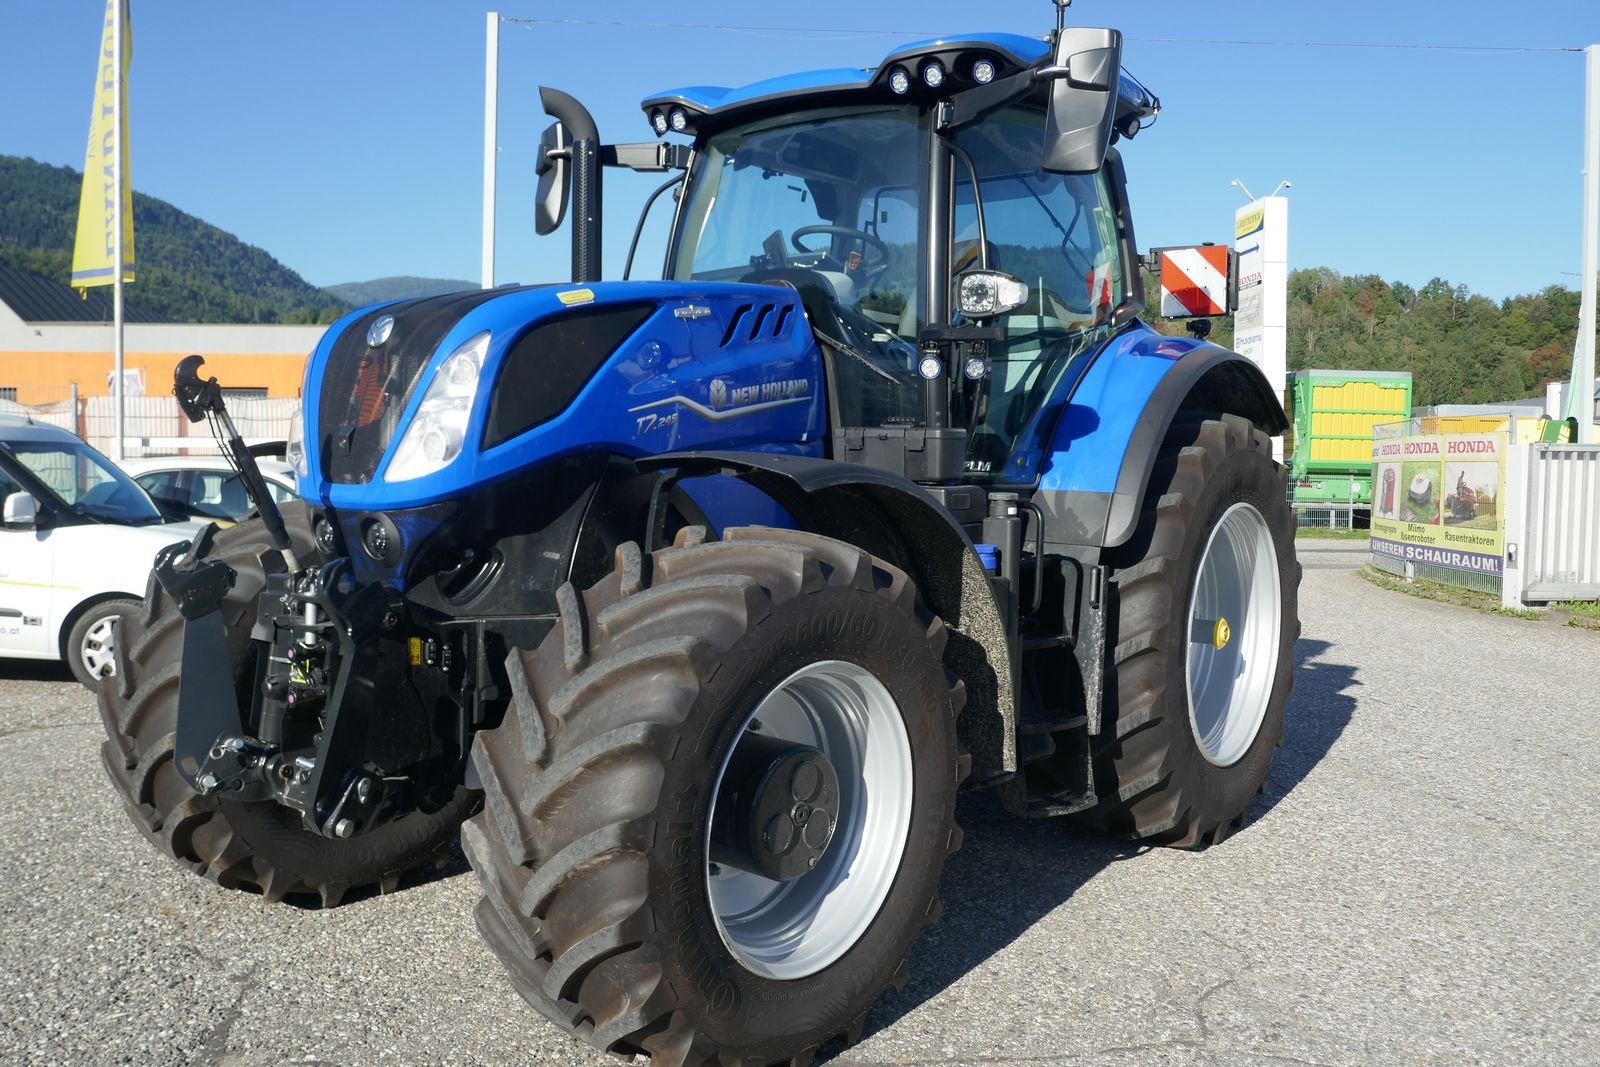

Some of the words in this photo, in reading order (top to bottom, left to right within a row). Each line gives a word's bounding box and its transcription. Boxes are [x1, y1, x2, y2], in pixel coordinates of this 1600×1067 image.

[731, 385, 760, 406] NEW
[761, 379, 809, 400] HOLLAND
[637, 413, 679, 435] T7.245
[1381, 444, 1401, 456] HONDA
[1403, 442, 1440, 455] HONDA
[1447, 440, 1496, 454] HONDA
[1444, 532, 1495, 547] Rasentraktoren
[1372, 540, 1404, 556] UNSEREN
[1406, 546, 1499, 571] SCHAURAUM!
